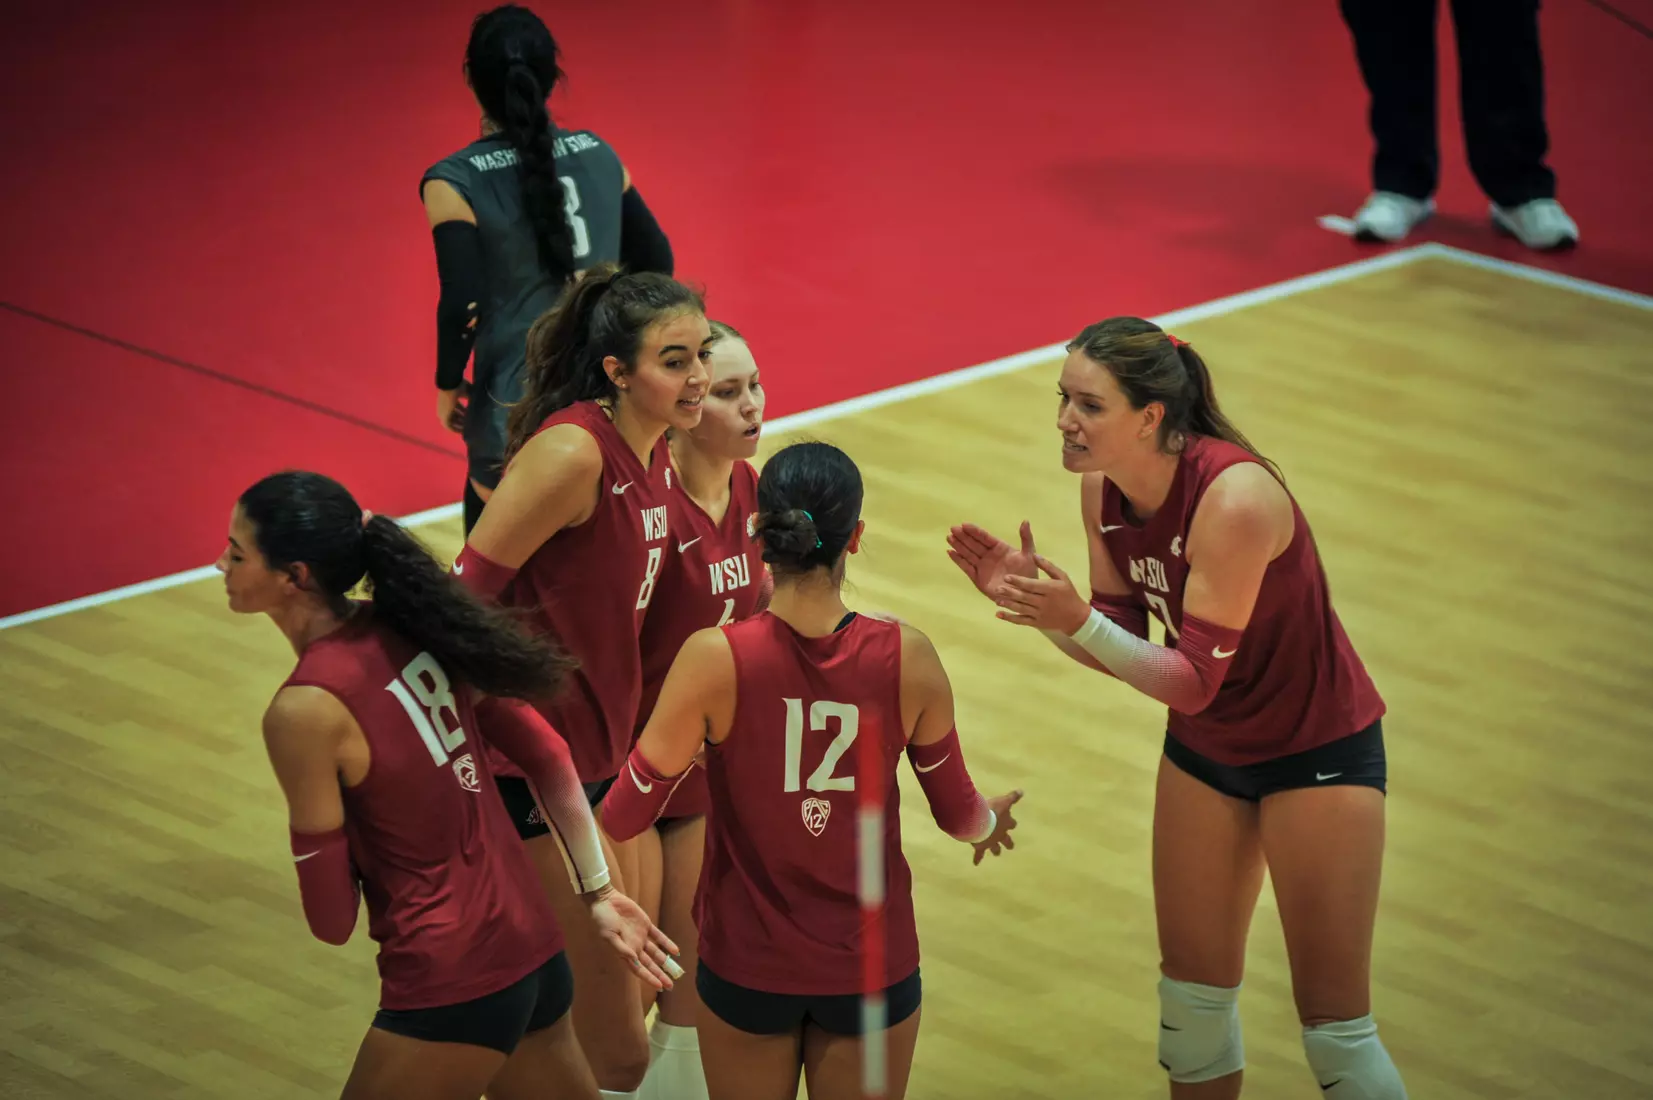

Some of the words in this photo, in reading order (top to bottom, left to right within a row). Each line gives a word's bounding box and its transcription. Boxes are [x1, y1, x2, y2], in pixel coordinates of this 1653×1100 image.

[469, 137, 568, 172] WASHN
[640, 505, 667, 542] WSU
[636, 547, 662, 610] 8
[708, 553, 750, 595] WSU
[1128, 555, 1170, 593] WSU
[1143, 591, 1181, 640] 7
[384, 651, 467, 767] 18
[781, 697, 859, 792] 12
[803, 800, 828, 822] PAC
[810, 813, 823, 829] 12
